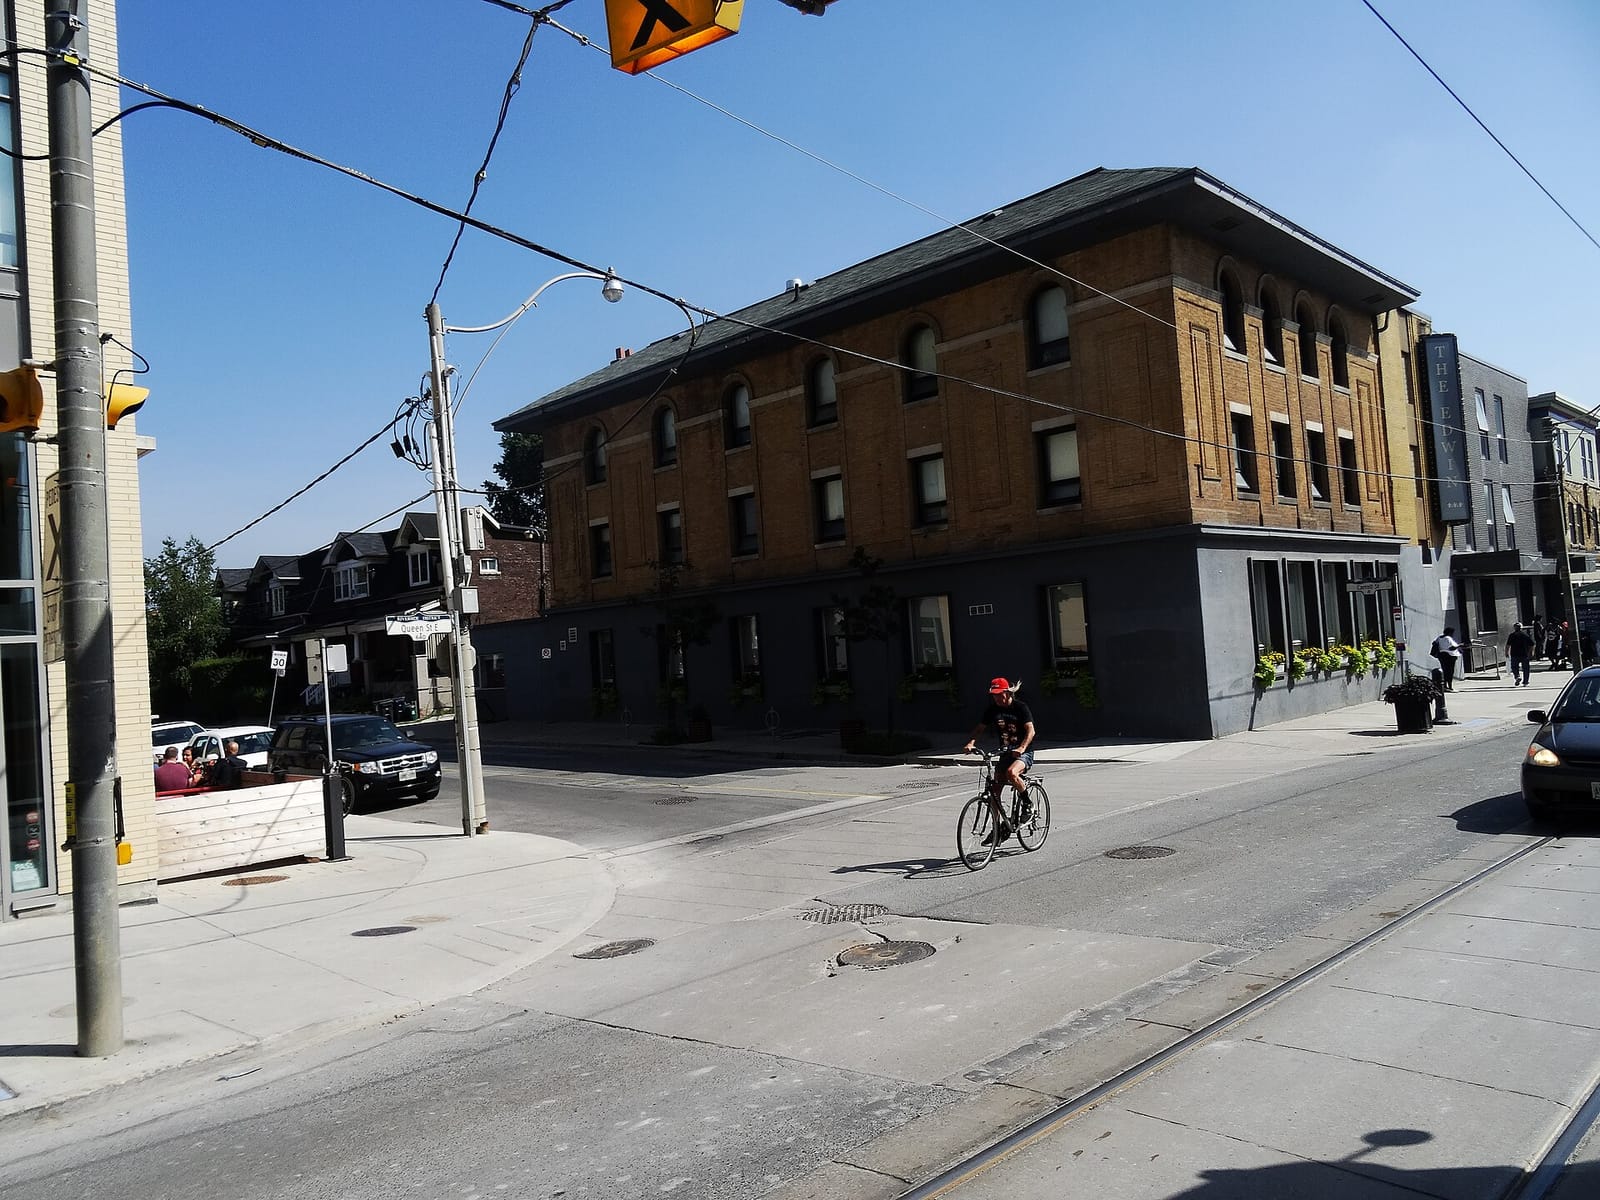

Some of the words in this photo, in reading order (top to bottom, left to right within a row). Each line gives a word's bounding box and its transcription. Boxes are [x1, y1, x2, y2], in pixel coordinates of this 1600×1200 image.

[1434, 345, 1449, 393] THE
[1441, 406, 1458, 488] EDWIN
[47, 602, 58, 623] STOP
[400, 624, 424, 633] Queen
[426, 623, 433, 632] St
[434, 623, 439, 632] E
[273, 658, 285, 667] 30
